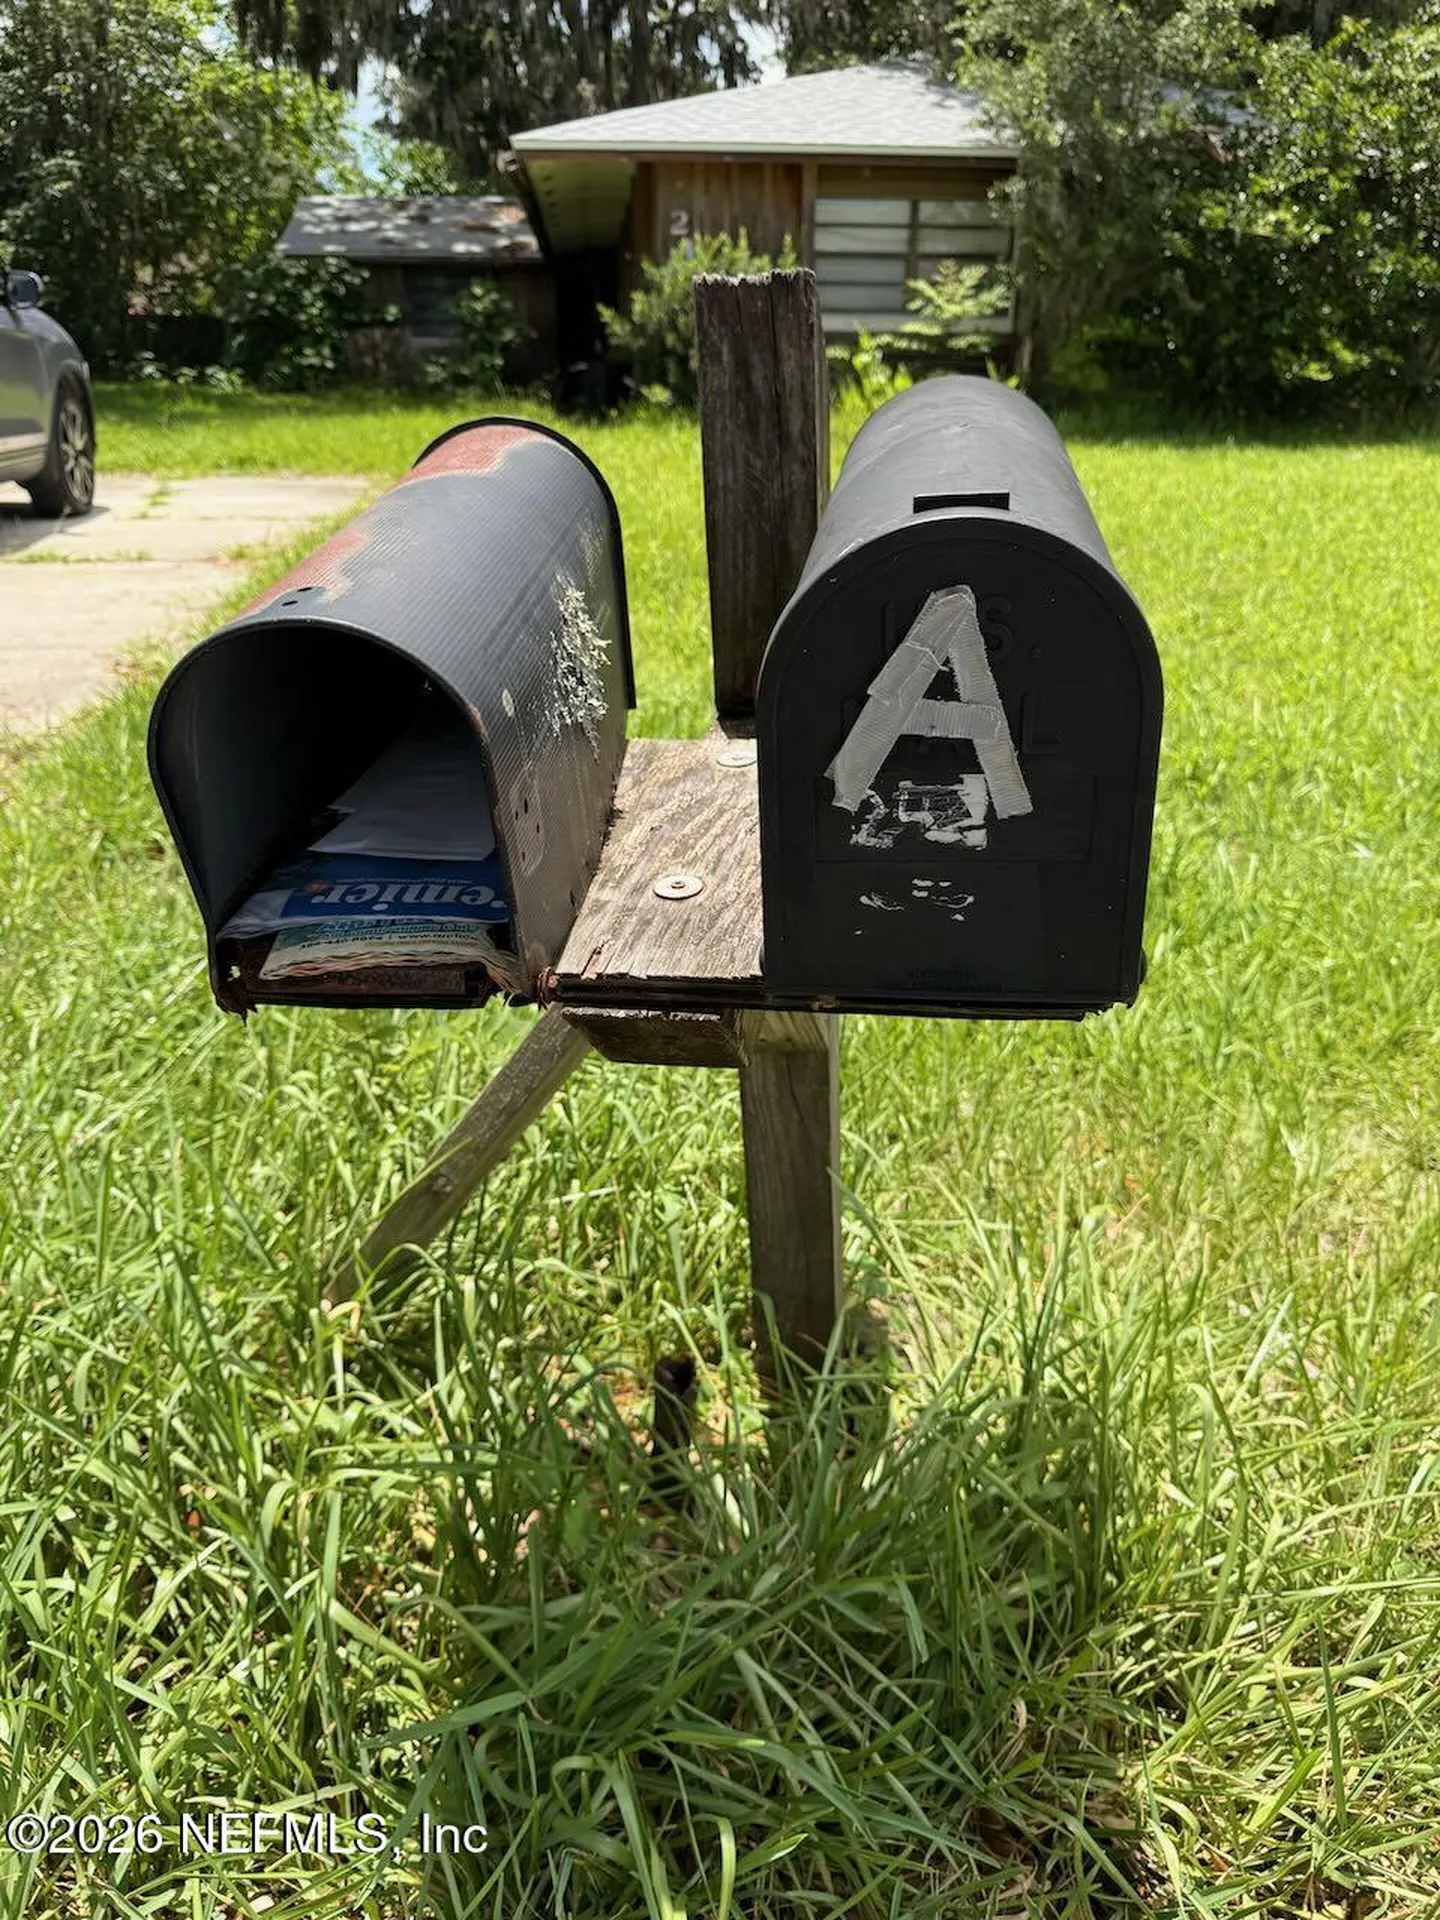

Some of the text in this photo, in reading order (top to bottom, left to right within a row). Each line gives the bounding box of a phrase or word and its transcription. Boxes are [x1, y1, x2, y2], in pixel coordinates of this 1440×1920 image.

[670, 209, 689, 236] 2
[822, 583, 1034, 820] A
[311, 883, 508, 911] emier
